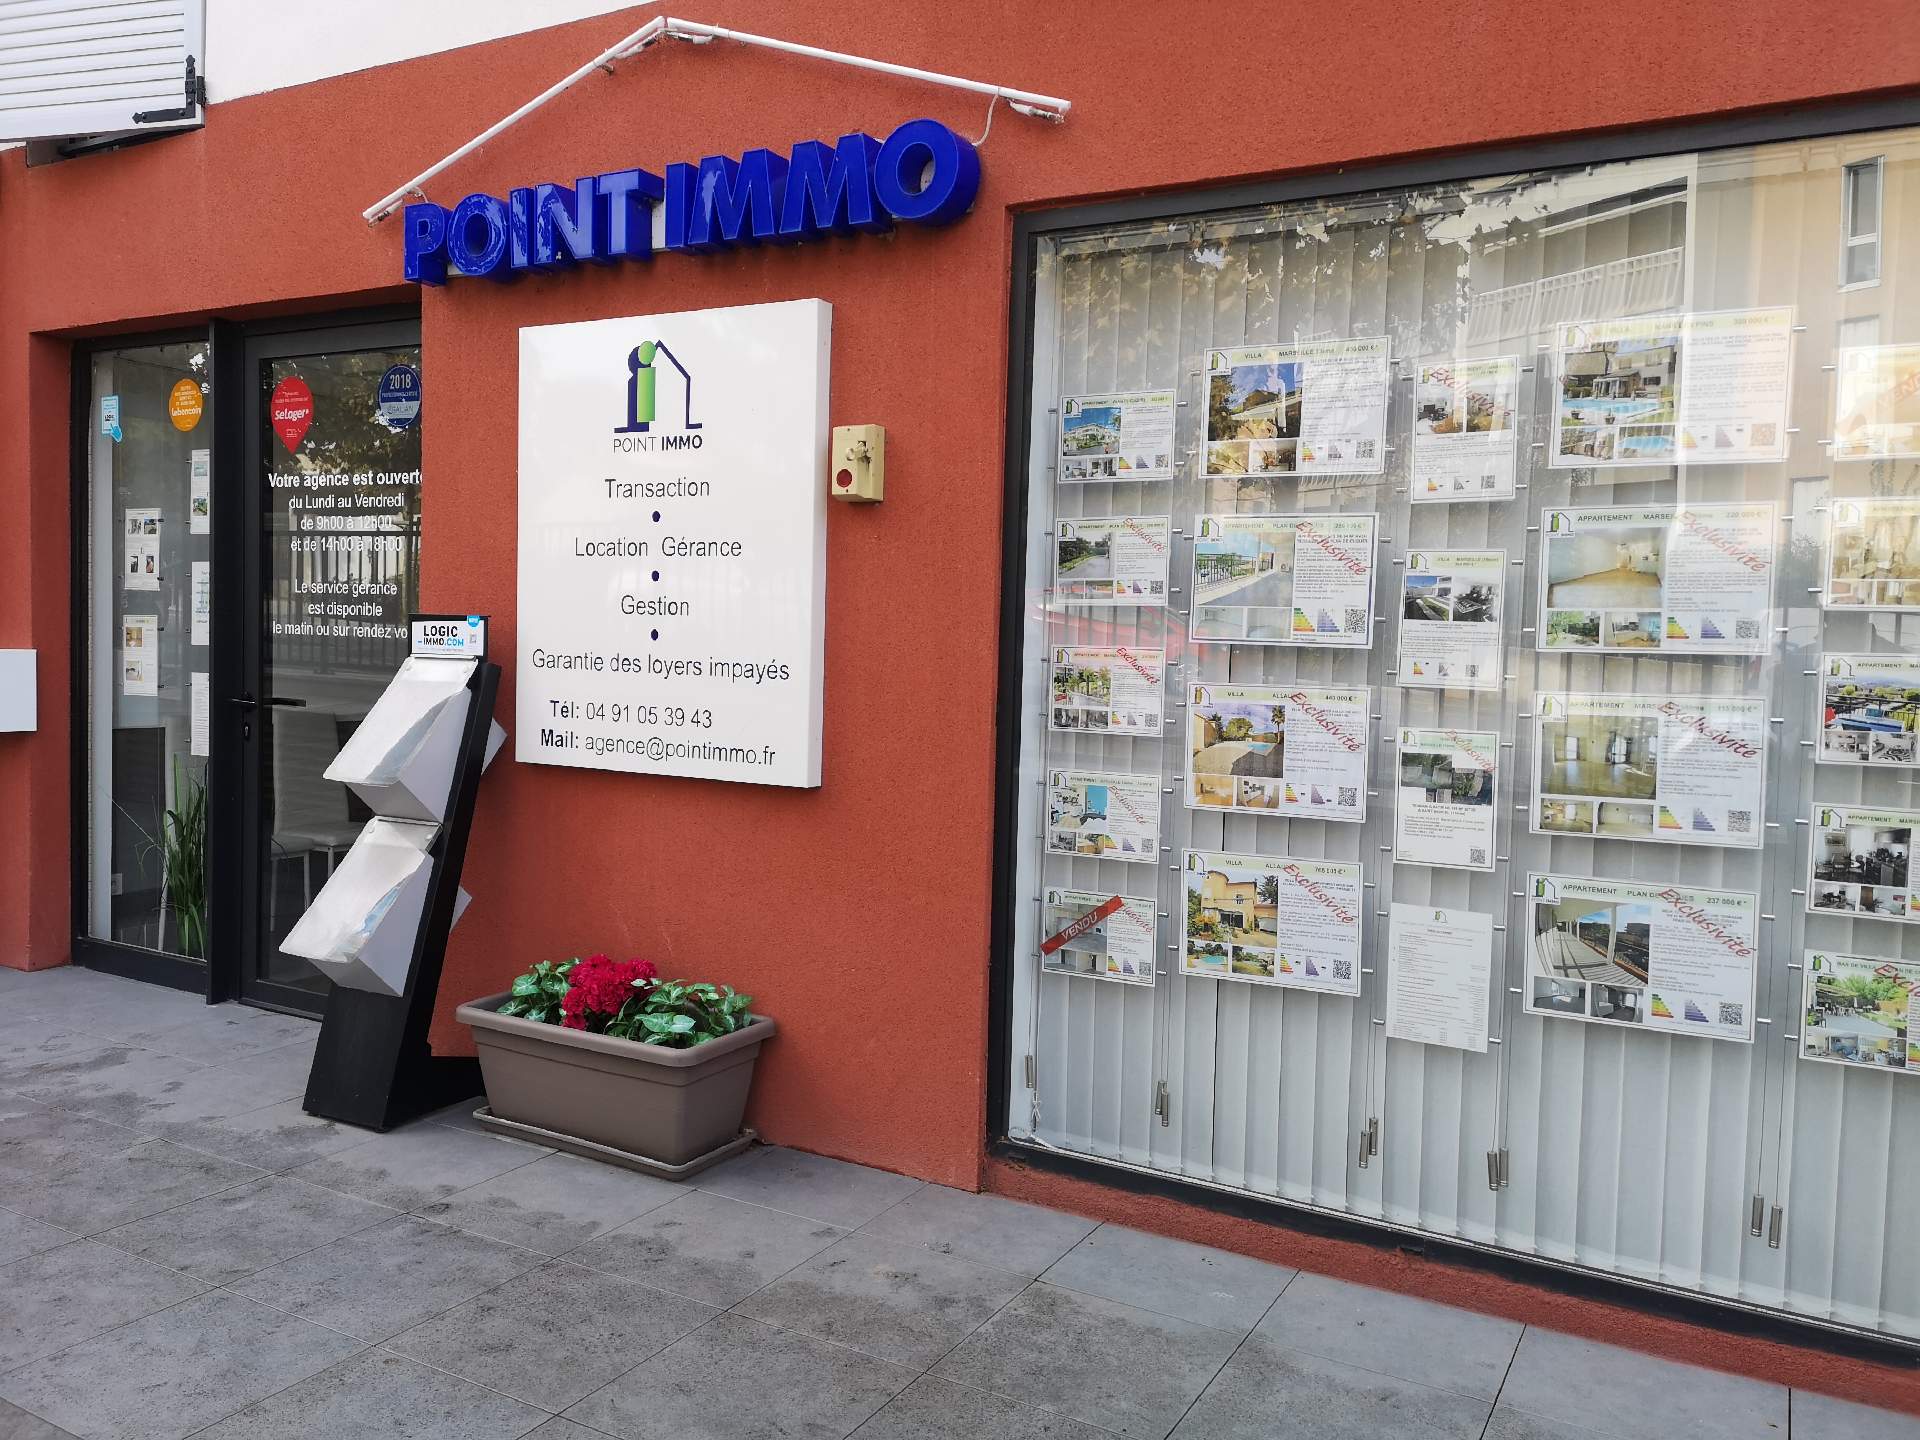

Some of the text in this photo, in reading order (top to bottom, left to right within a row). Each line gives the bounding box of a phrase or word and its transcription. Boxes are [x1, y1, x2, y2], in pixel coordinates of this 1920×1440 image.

[404, 118, 978, 284] POINT IMMO
[390, 374, 411, 390] 2018
[613, 434, 703, 453] POINT IMMO
[268, 472, 300, 488] Votre
[304, 472, 350, 490] agence
[352, 470, 374, 486] est
[604, 478, 710, 498] Transaction
[288, 492, 404, 508] du Lundi au Vendredi
[300, 516, 314, 530] de
[316, 516, 344, 530] 9h00
[360, 515, 392, 529] 12h00
[1578, 514, 1633, 522] APPARTEMENT
[290, 539, 302, 552] et
[304, 538, 316, 552] de
[320, 536, 354, 552] 14h00
[368, 536, 402, 552] 18h00
[575, 534, 742, 558] Location Gérance
[1295, 521, 1369, 576] Exclusivité
[1678, 510, 1770, 573] Exclusivité
[294, 579, 398, 598] Le service gérance
[308, 602, 382, 618] est disponible
[621, 595, 690, 616] Gestion
[272, 620, 282, 634] le
[285, 622, 313, 636] matin
[316, 624, 330, 636] ou
[332, 624, 349, 637] sur
[354, 624, 392, 638] rendez
[424, 626, 458, 637] LOGIC
[532, 648, 790, 684] Garantie des loyers impayés
[1116, 646, 1160, 686] Exclusivité
[550, 700, 712, 728] Tél: 04 91 05 39 43
[1291, 692, 1364, 752] Exclusivité
[1658, 701, 1762, 760] Exclusivité
[540, 729, 776, 766] Mail: agence@pointimmo.fr
[1848, 814, 1892, 823] APPARTEMENT
[1282, 863, 1355, 926] Exclusivité
[1562, 884, 1617, 895] APPARTEMENT
[1061, 911, 1098, 940] VENDU
[1658, 888, 1758, 959] Exclusivité
